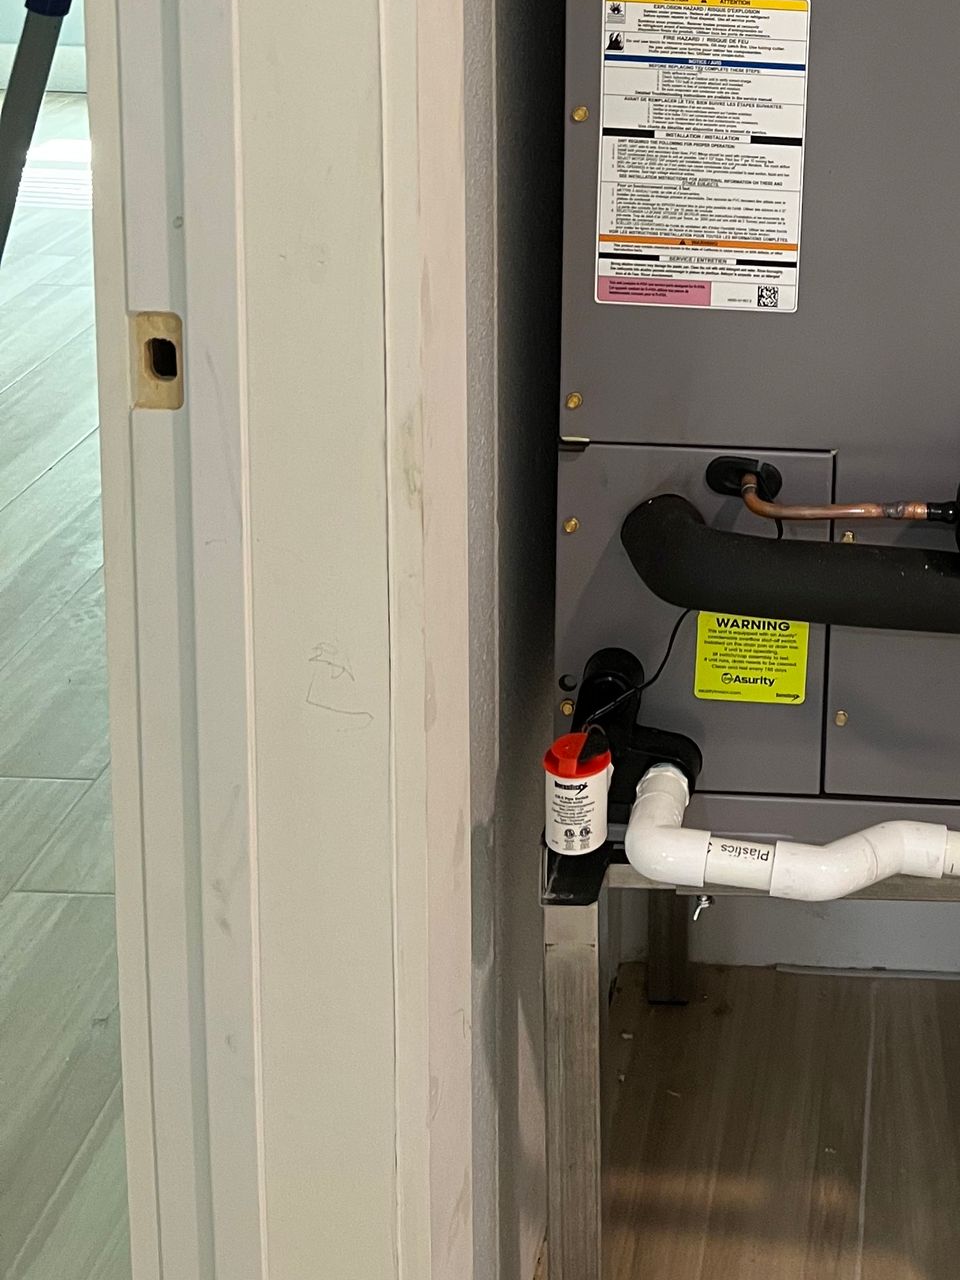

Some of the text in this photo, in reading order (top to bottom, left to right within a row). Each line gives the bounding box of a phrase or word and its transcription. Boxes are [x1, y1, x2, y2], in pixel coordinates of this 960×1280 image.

[716, 618, 790, 631] WARNING
[734, 675, 775, 687] Asurity
[721, 844, 770, 861] Plastics
